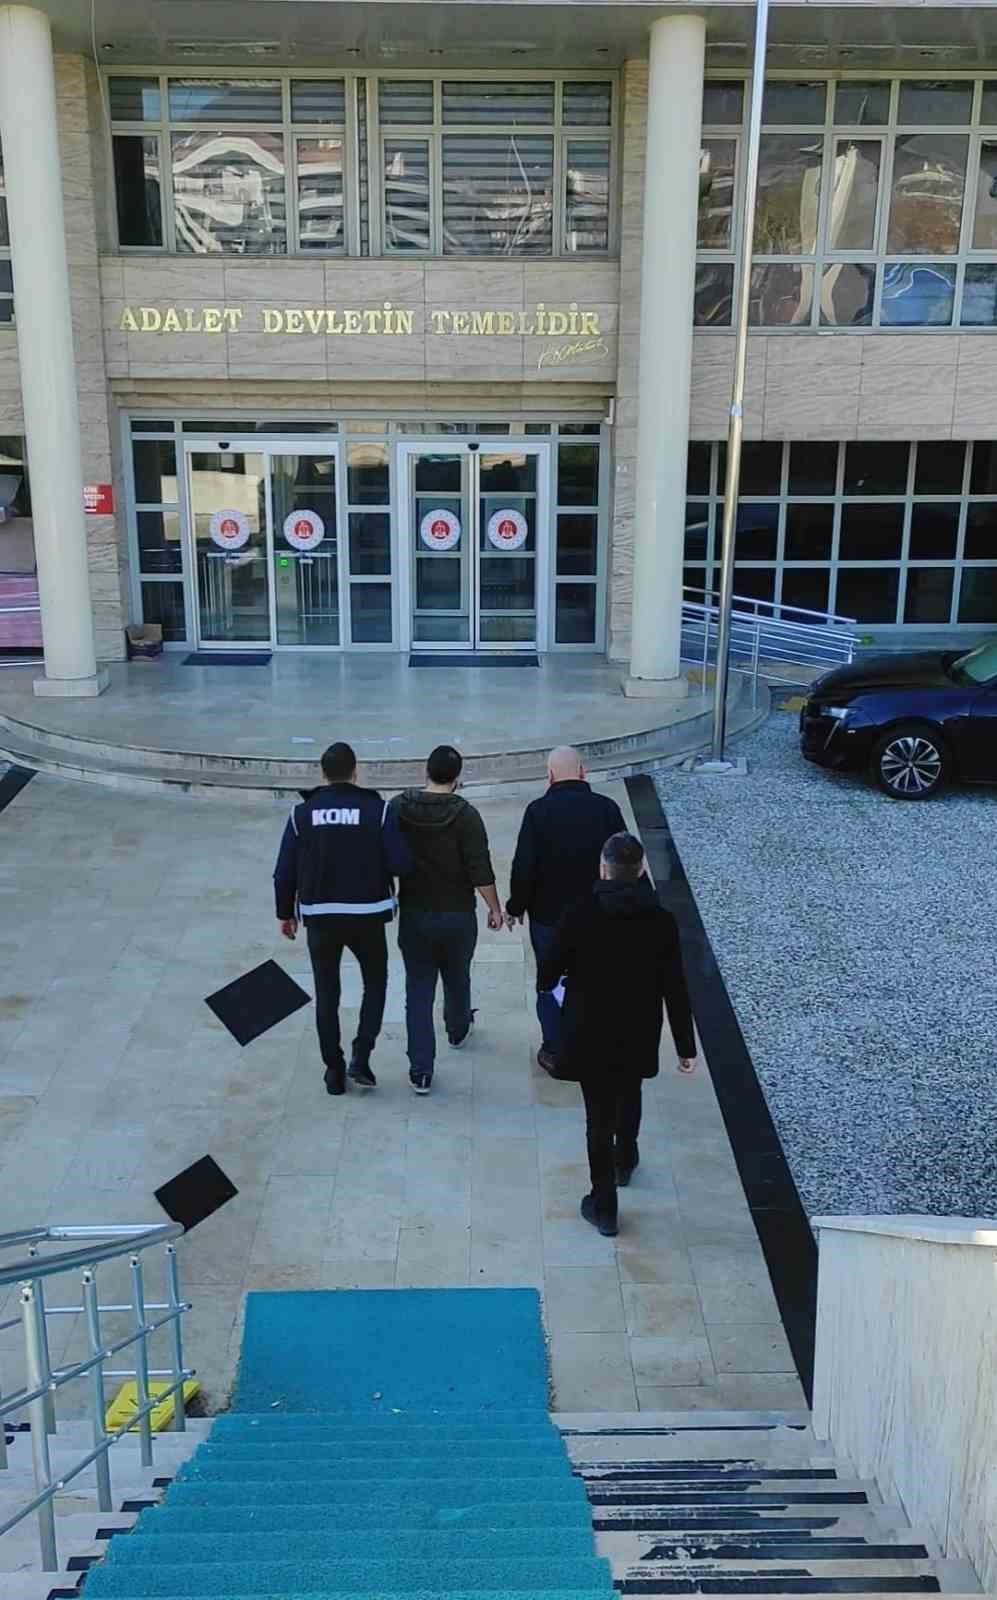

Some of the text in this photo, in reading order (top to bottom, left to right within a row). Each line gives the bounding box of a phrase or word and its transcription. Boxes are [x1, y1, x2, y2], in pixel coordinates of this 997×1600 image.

[120, 302, 601, 335] ADALET DEVLETİN TEMELİDİR
[312, 808, 360, 826] KOM
